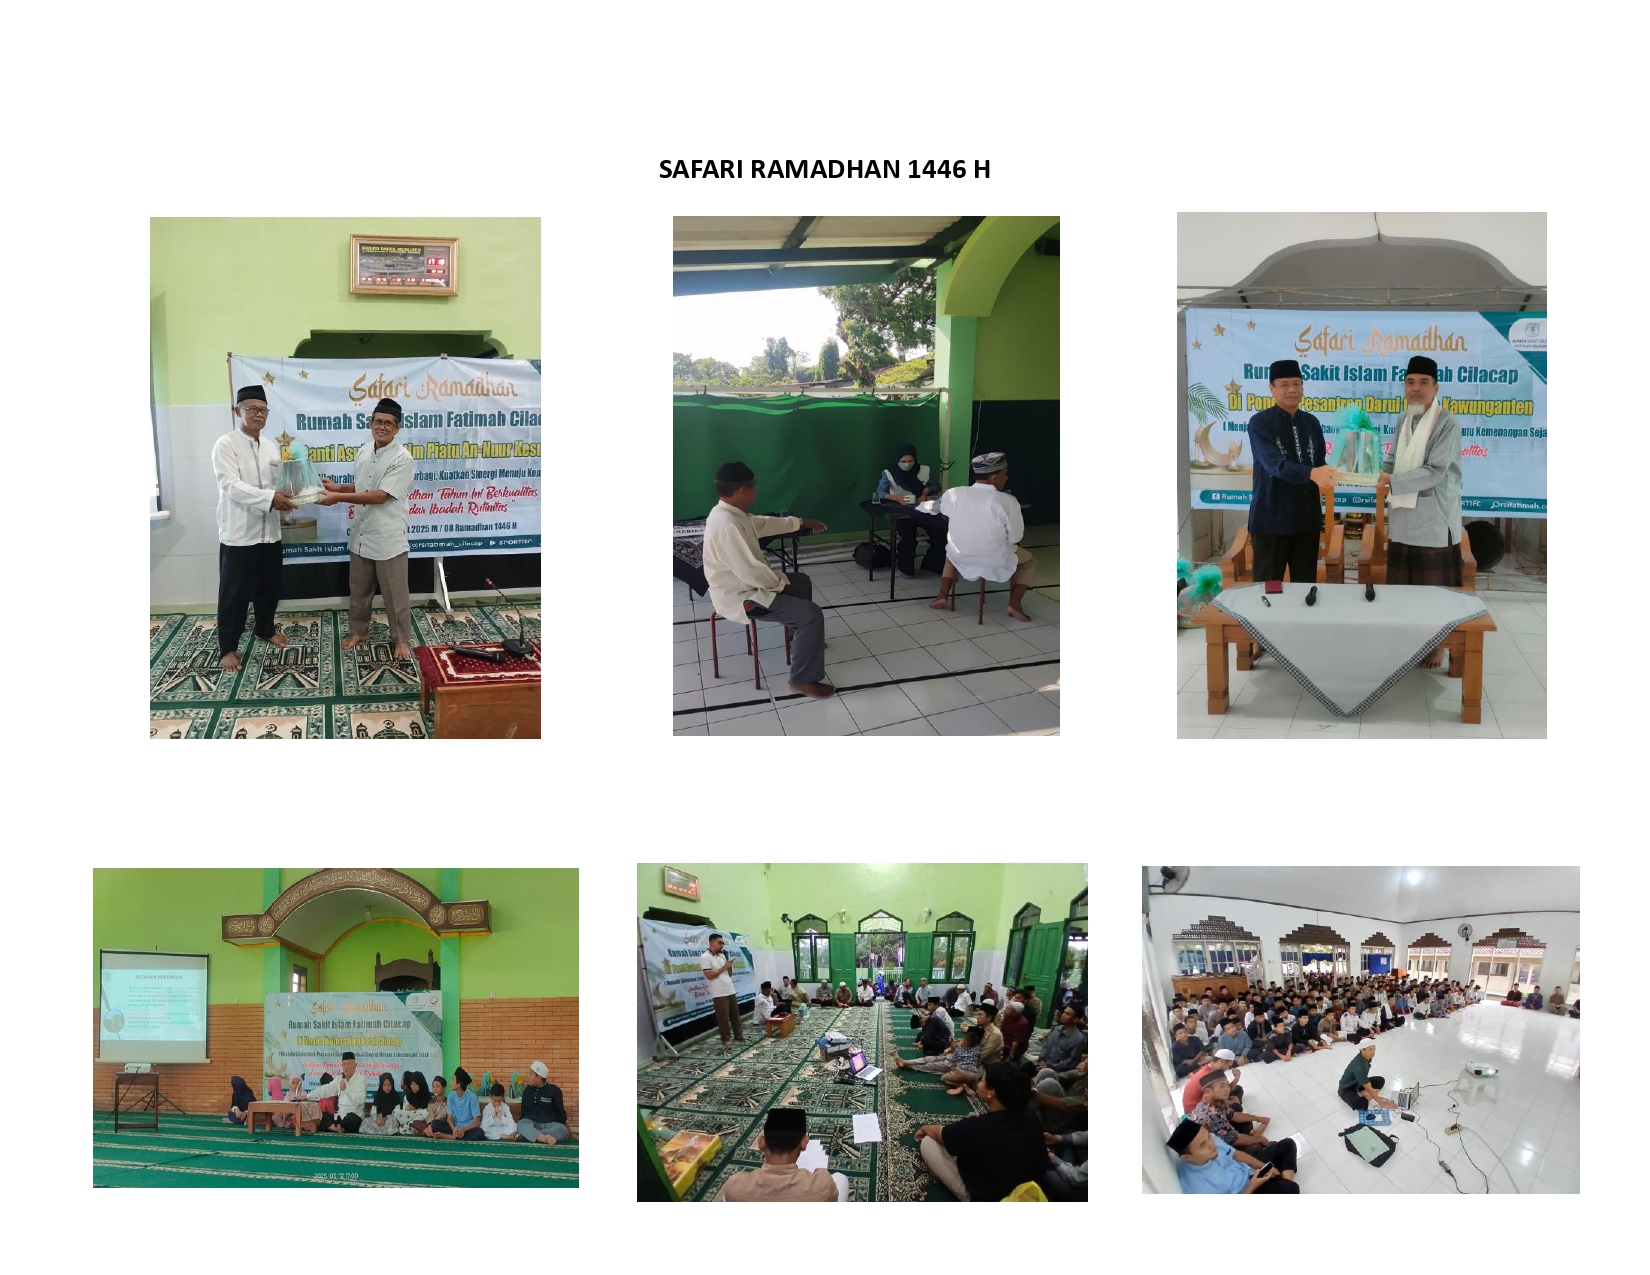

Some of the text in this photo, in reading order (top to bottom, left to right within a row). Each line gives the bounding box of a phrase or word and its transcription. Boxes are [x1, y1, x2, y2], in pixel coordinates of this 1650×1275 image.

[1294, 323, 1468, 358] Safari Ramadhan
[1301, 363, 1340, 381] Sakit
[1343, 365, 1383, 382] Islam
[1392, 365, 1453, 382] Faah
[1458, 366, 1519, 385] Cilacap
[348, 370, 518, 407] Safari Ramadhan
[1228, 392, 1242, 412] Di
[1366, 396, 1401, 414] Darul
[1443, 396, 1534, 417] Kawunganten
[296, 412, 353, 431] Rumah
[401, 411, 443, 429] Islam
[446, 410, 507, 428] Fatimah
[1476, 426, 1528, 438] Kemenangan
[1530, 427, 1547, 438] Seja
[426, 442, 460, 459] Piatu
[461, 440, 513, 458] An-Nuur
[440, 469, 471, 480] Kuatkan
[471, 468, 498, 480] Sinergi
[499, 467, 526, 479] Menuju
[437, 487, 468, 500] Tahun
[486, 485, 538, 500] Berkualitas
[429, 502, 464, 515] Ibadah
[412, 524, 430, 534] 2025
[431, 524, 438, 533] M
[444, 524, 454, 532] 08
[455, 522, 493, 532] Ramadhan
[494, 522, 511, 530] 1446
[512, 521, 517, 529] H
[304, 545, 323, 553] Sakit
[324, 545, 345, 553] Islam
[288, 1019, 412, 1030] Rumah Sakit Islam Fatimah Cilacap
